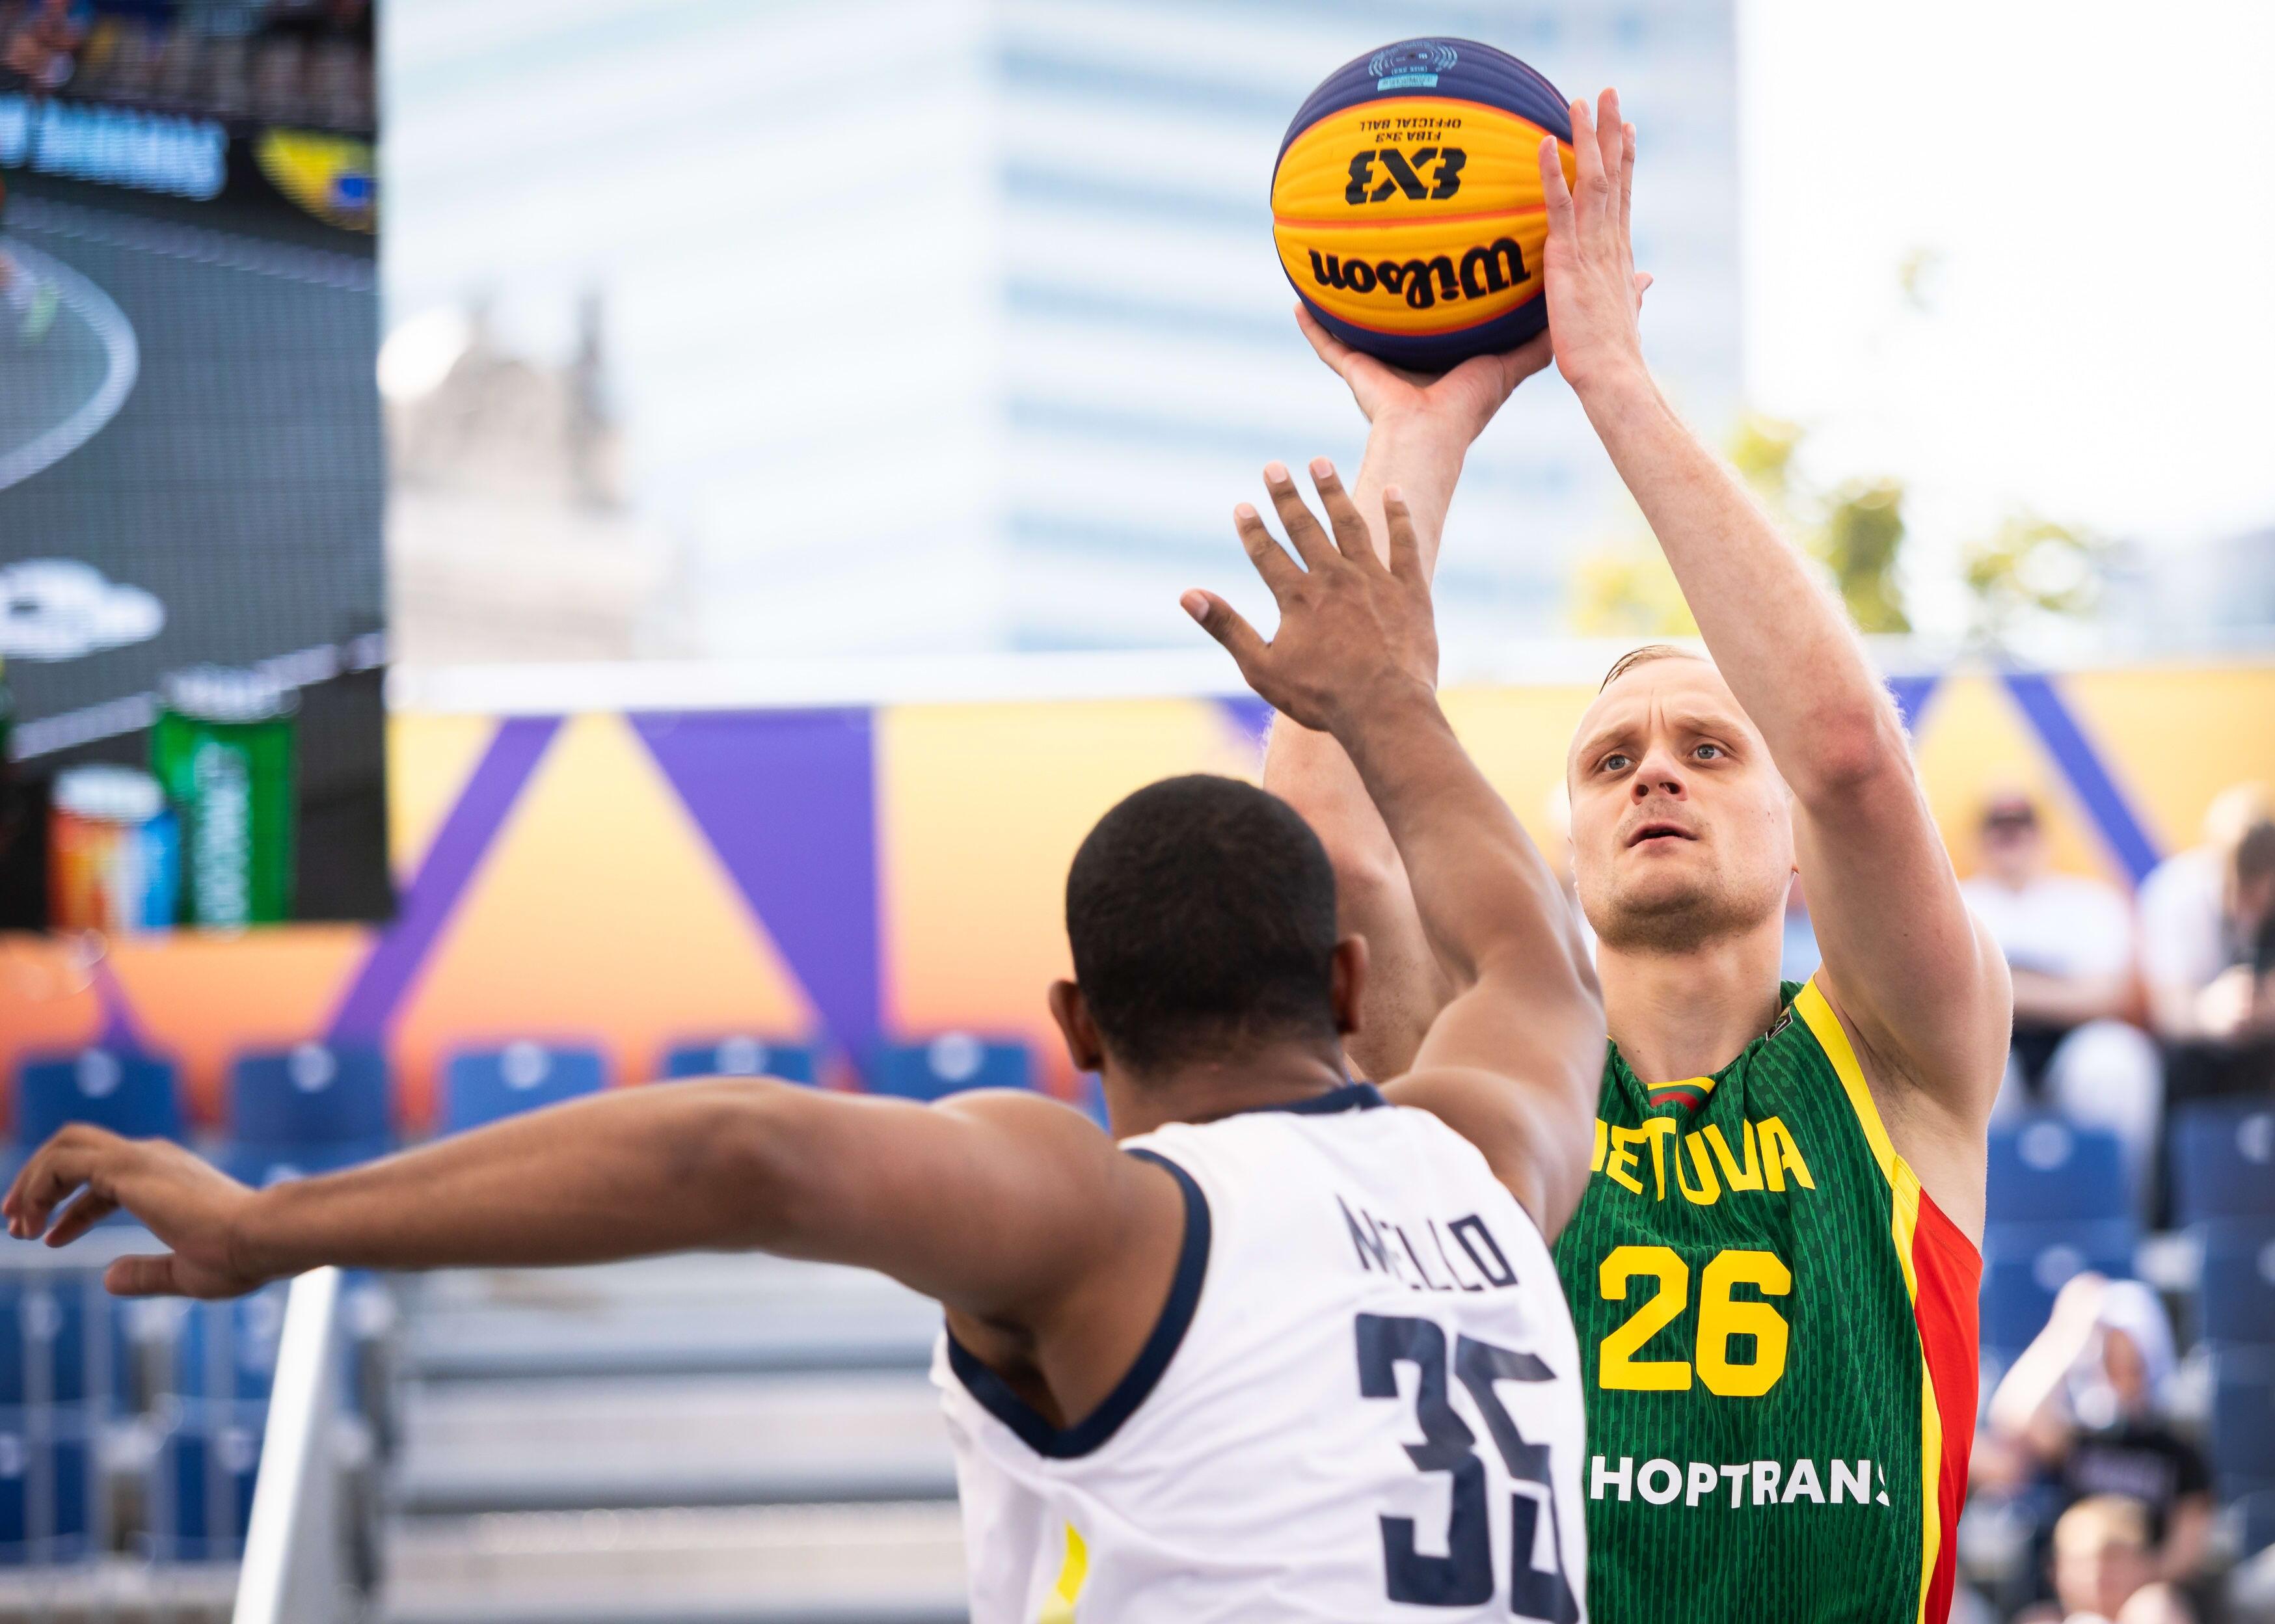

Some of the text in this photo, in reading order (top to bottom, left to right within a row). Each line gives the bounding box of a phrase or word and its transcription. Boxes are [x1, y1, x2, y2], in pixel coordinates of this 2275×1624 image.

[1360, 118, 1462, 131] OFFICIAL BALL
[1407, 131, 1441, 141] FIBA
[1308, 237, 1531, 309] Wilson
[1589, 1116, 1816, 1205] IETUVA
[1599, 1246, 1791, 1396] 26
[1355, 1312, 1580, 1623] 35
